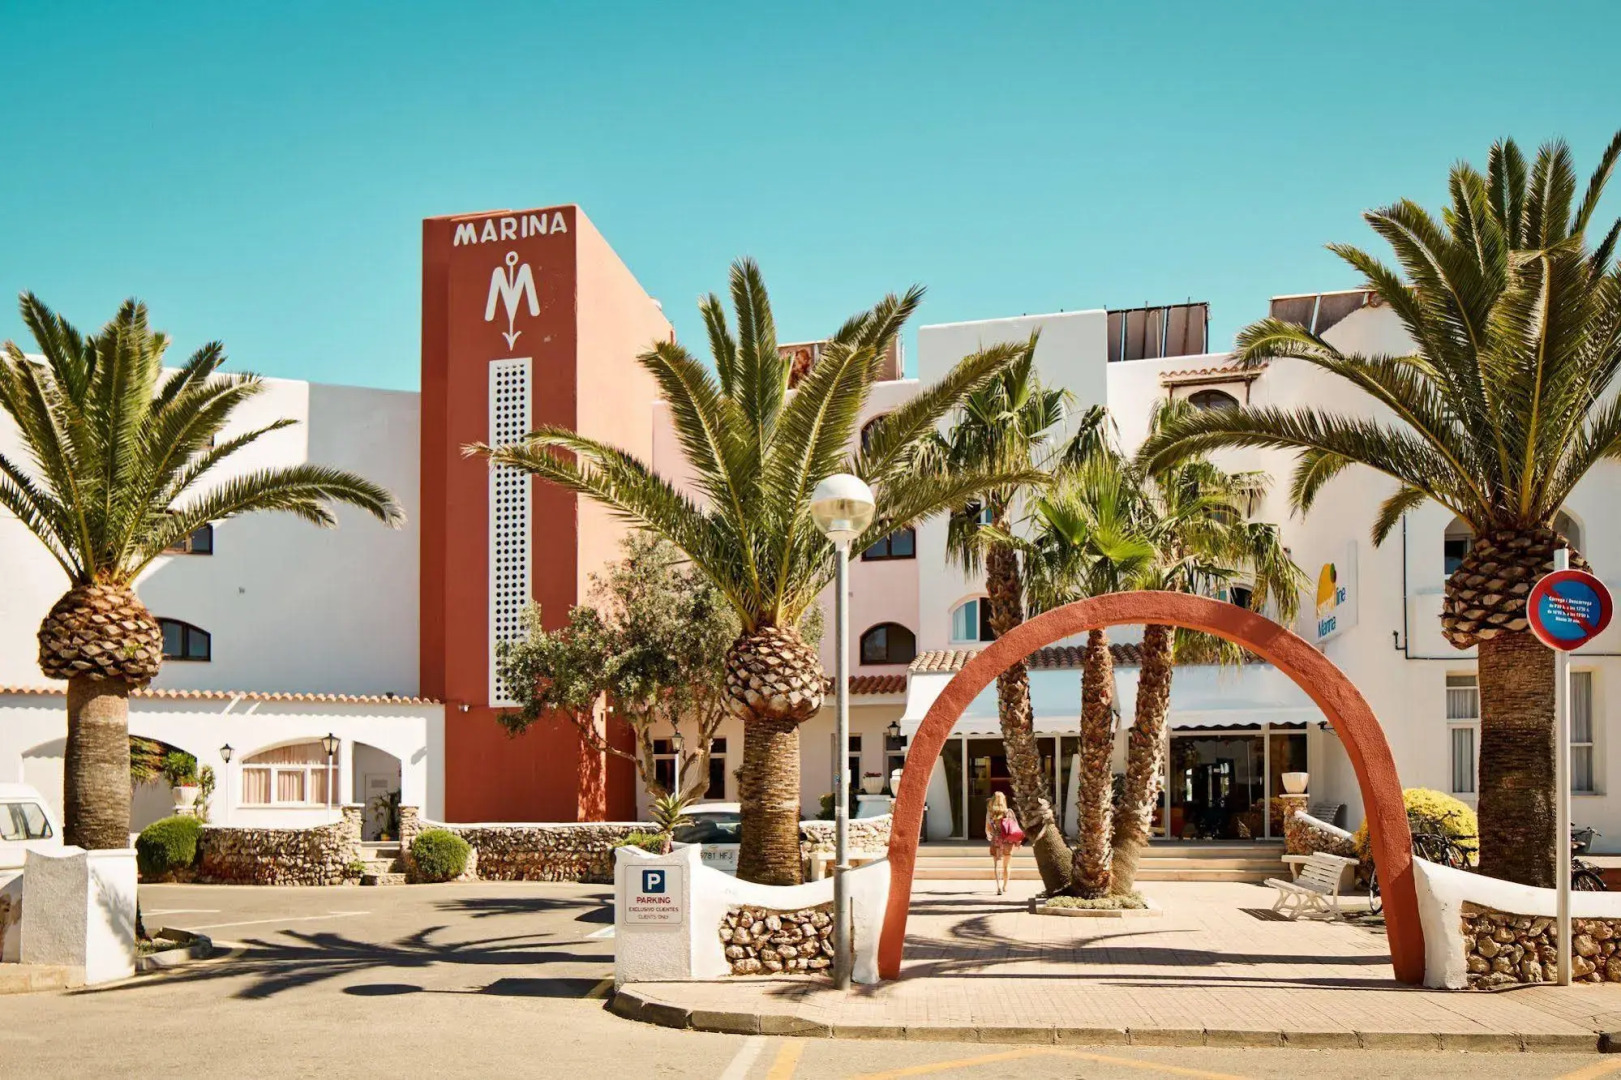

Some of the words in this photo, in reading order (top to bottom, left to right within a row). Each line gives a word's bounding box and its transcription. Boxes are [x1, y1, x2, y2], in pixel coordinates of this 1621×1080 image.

[453, 211, 568, 247] MARINA
[647, 873, 662, 890] P
[636, 896, 671, 904] PARKING
